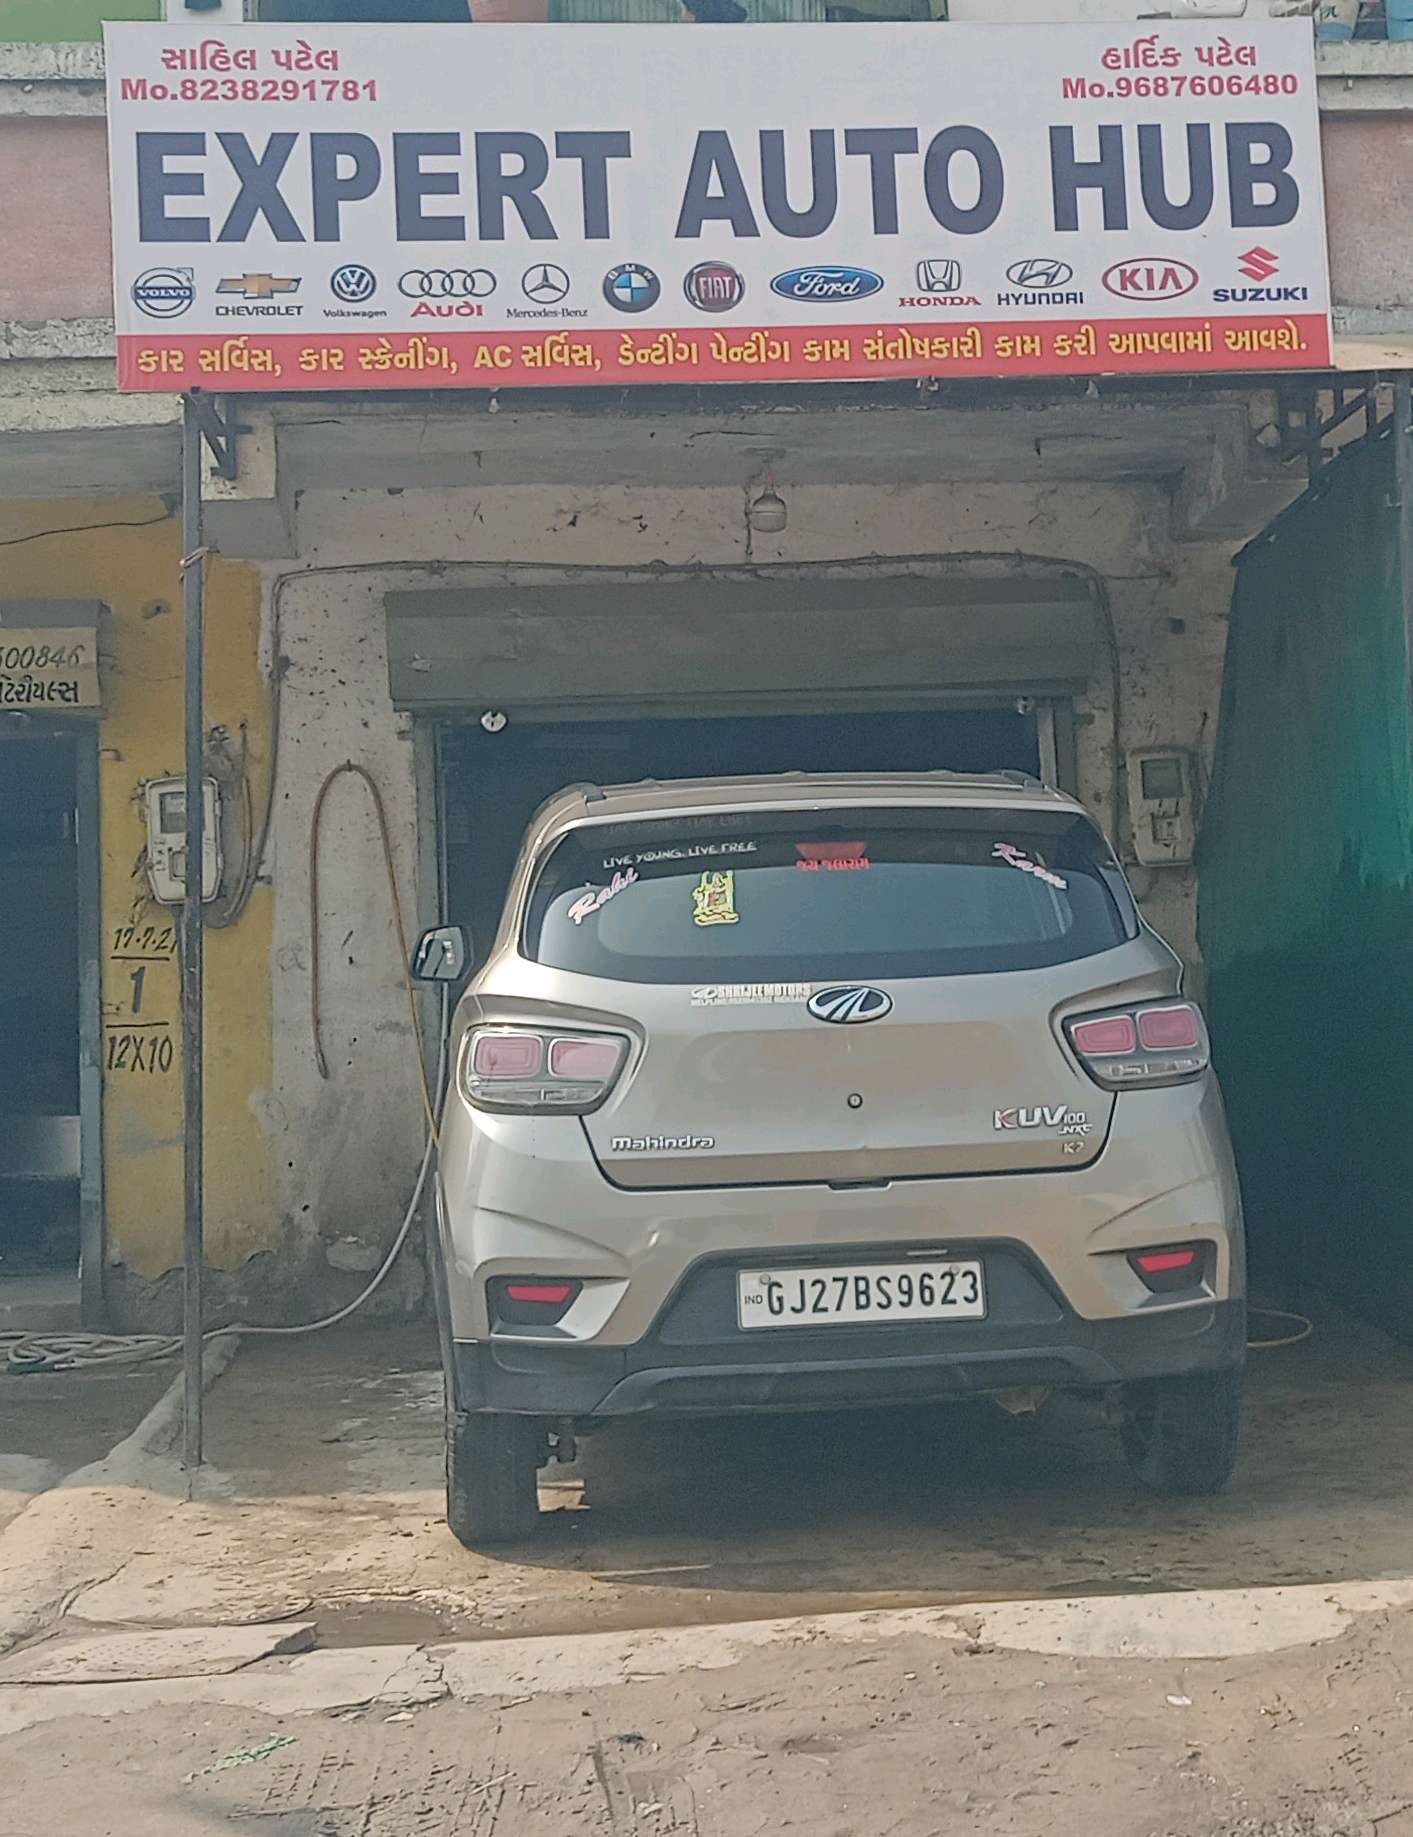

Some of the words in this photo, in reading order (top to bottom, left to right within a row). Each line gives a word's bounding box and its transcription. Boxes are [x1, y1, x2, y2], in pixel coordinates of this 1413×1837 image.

[161, 39, 257, 72] સાહિલ
[271, 39, 339, 71] પટેલ
[1101, 34, 1181, 69] હાર્દિક
[1195, 36, 1257, 67] પટેલ
[121, 78, 377, 101] Mo.8238291781
[1062, 73, 1298, 98] Mo.9687606480
[136, 130, 632, 243] EXPERT
[675, 125, 1004, 239] AUTO
[1048, 121, 1300, 232] HUB
[699, 276, 733, 300] FIAT
[793, 271, 861, 296] Ford
[1119, 267, 1183, 291] KIA
[137, 287, 190, 299] VOLVO
[899, 295, 982, 308] HONDA
[996, 291, 1084, 306] HYUNDAI
[1213, 286, 1309, 302] SUZUKI
[216, 304, 304, 317] CHEVROLET
[323, 308, 388, 319] Volkswagen
[410, 301, 484, 318] Audi
[506, 307, 588, 319] Mercedes-Benz
[138, 348, 185, 373] કાર
[198, 336, 282, 376] સર્વિસ,
[299, 347, 344, 371] કાર
[358, 336, 459, 374] સ્કેનીંગ,
[474, 345, 512, 368] AC
[521, 331, 602, 371] સર્વિસ,
[617, 333, 698, 366] ડેન્ટીંગ
[710, 331, 790, 364] પેન્ટીંગ
[803, 338, 850, 362] કામ
[863, 326, 982, 361] સંતોષકારી
[994, 334, 1041, 357] કામ
[1053, 324, 1096, 356] કરી
[1108, 322, 1212, 354] આપવામાં
[1225, 319, 1308, 351] આવશે.
[602, 854, 633, 868] LIVE
[688, 844, 718, 857] LIVE
[721, 841, 758, 853] FREE
[130, 966, 146, 1014] 1
[744, 1294, 764, 1305] IND
[767, 1269, 979, 1316] GJ27BS9623
